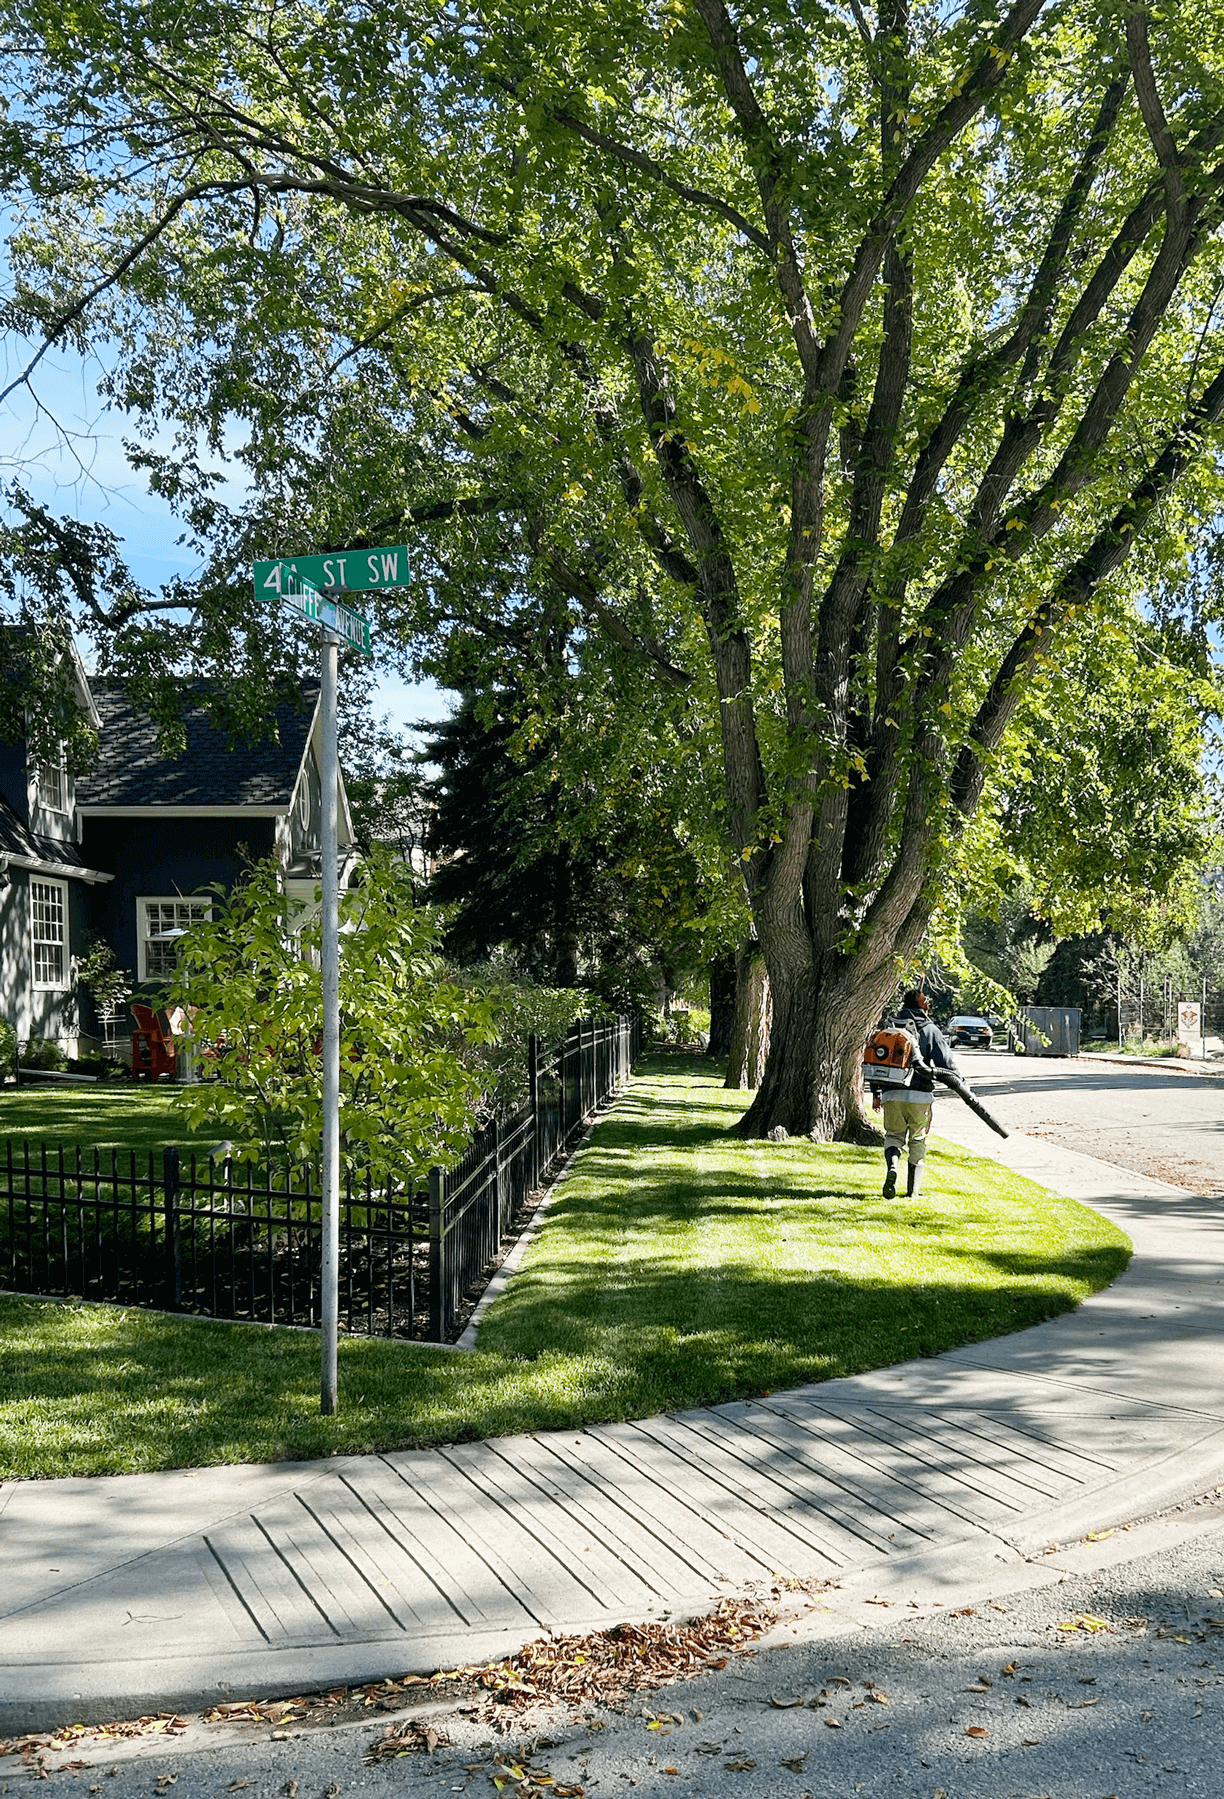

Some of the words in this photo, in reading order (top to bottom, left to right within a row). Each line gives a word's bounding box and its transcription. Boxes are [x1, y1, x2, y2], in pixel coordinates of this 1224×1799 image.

[323, 558, 347, 587] ST
[367, 553, 398, 583] SW
[336, 605, 368, 649] AVENUE
